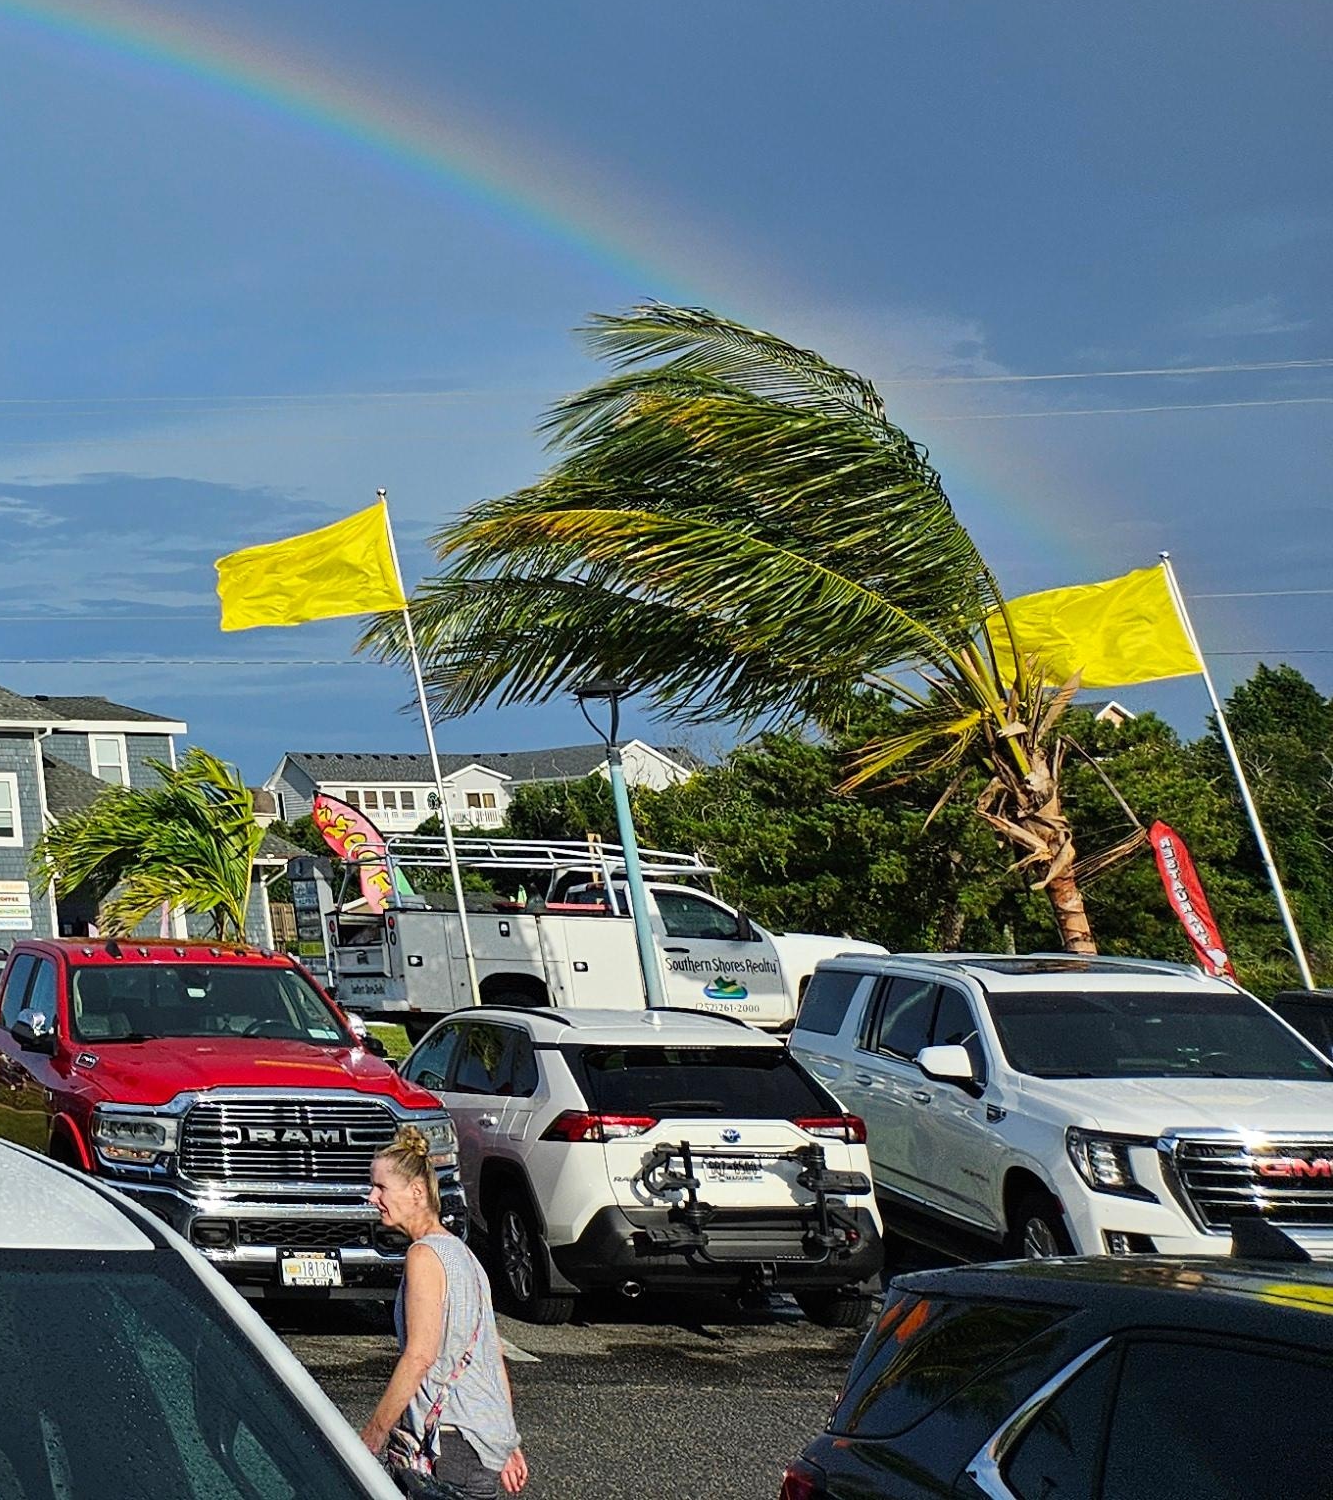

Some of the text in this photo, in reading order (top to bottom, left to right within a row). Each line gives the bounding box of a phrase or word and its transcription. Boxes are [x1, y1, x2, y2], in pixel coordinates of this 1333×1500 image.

[665, 956, 712, 974] Southern
[712, 957, 746, 974] Shores
[248, 1128, 340, 1143] RAM
[1257, 1158, 1333, 1178] GM
